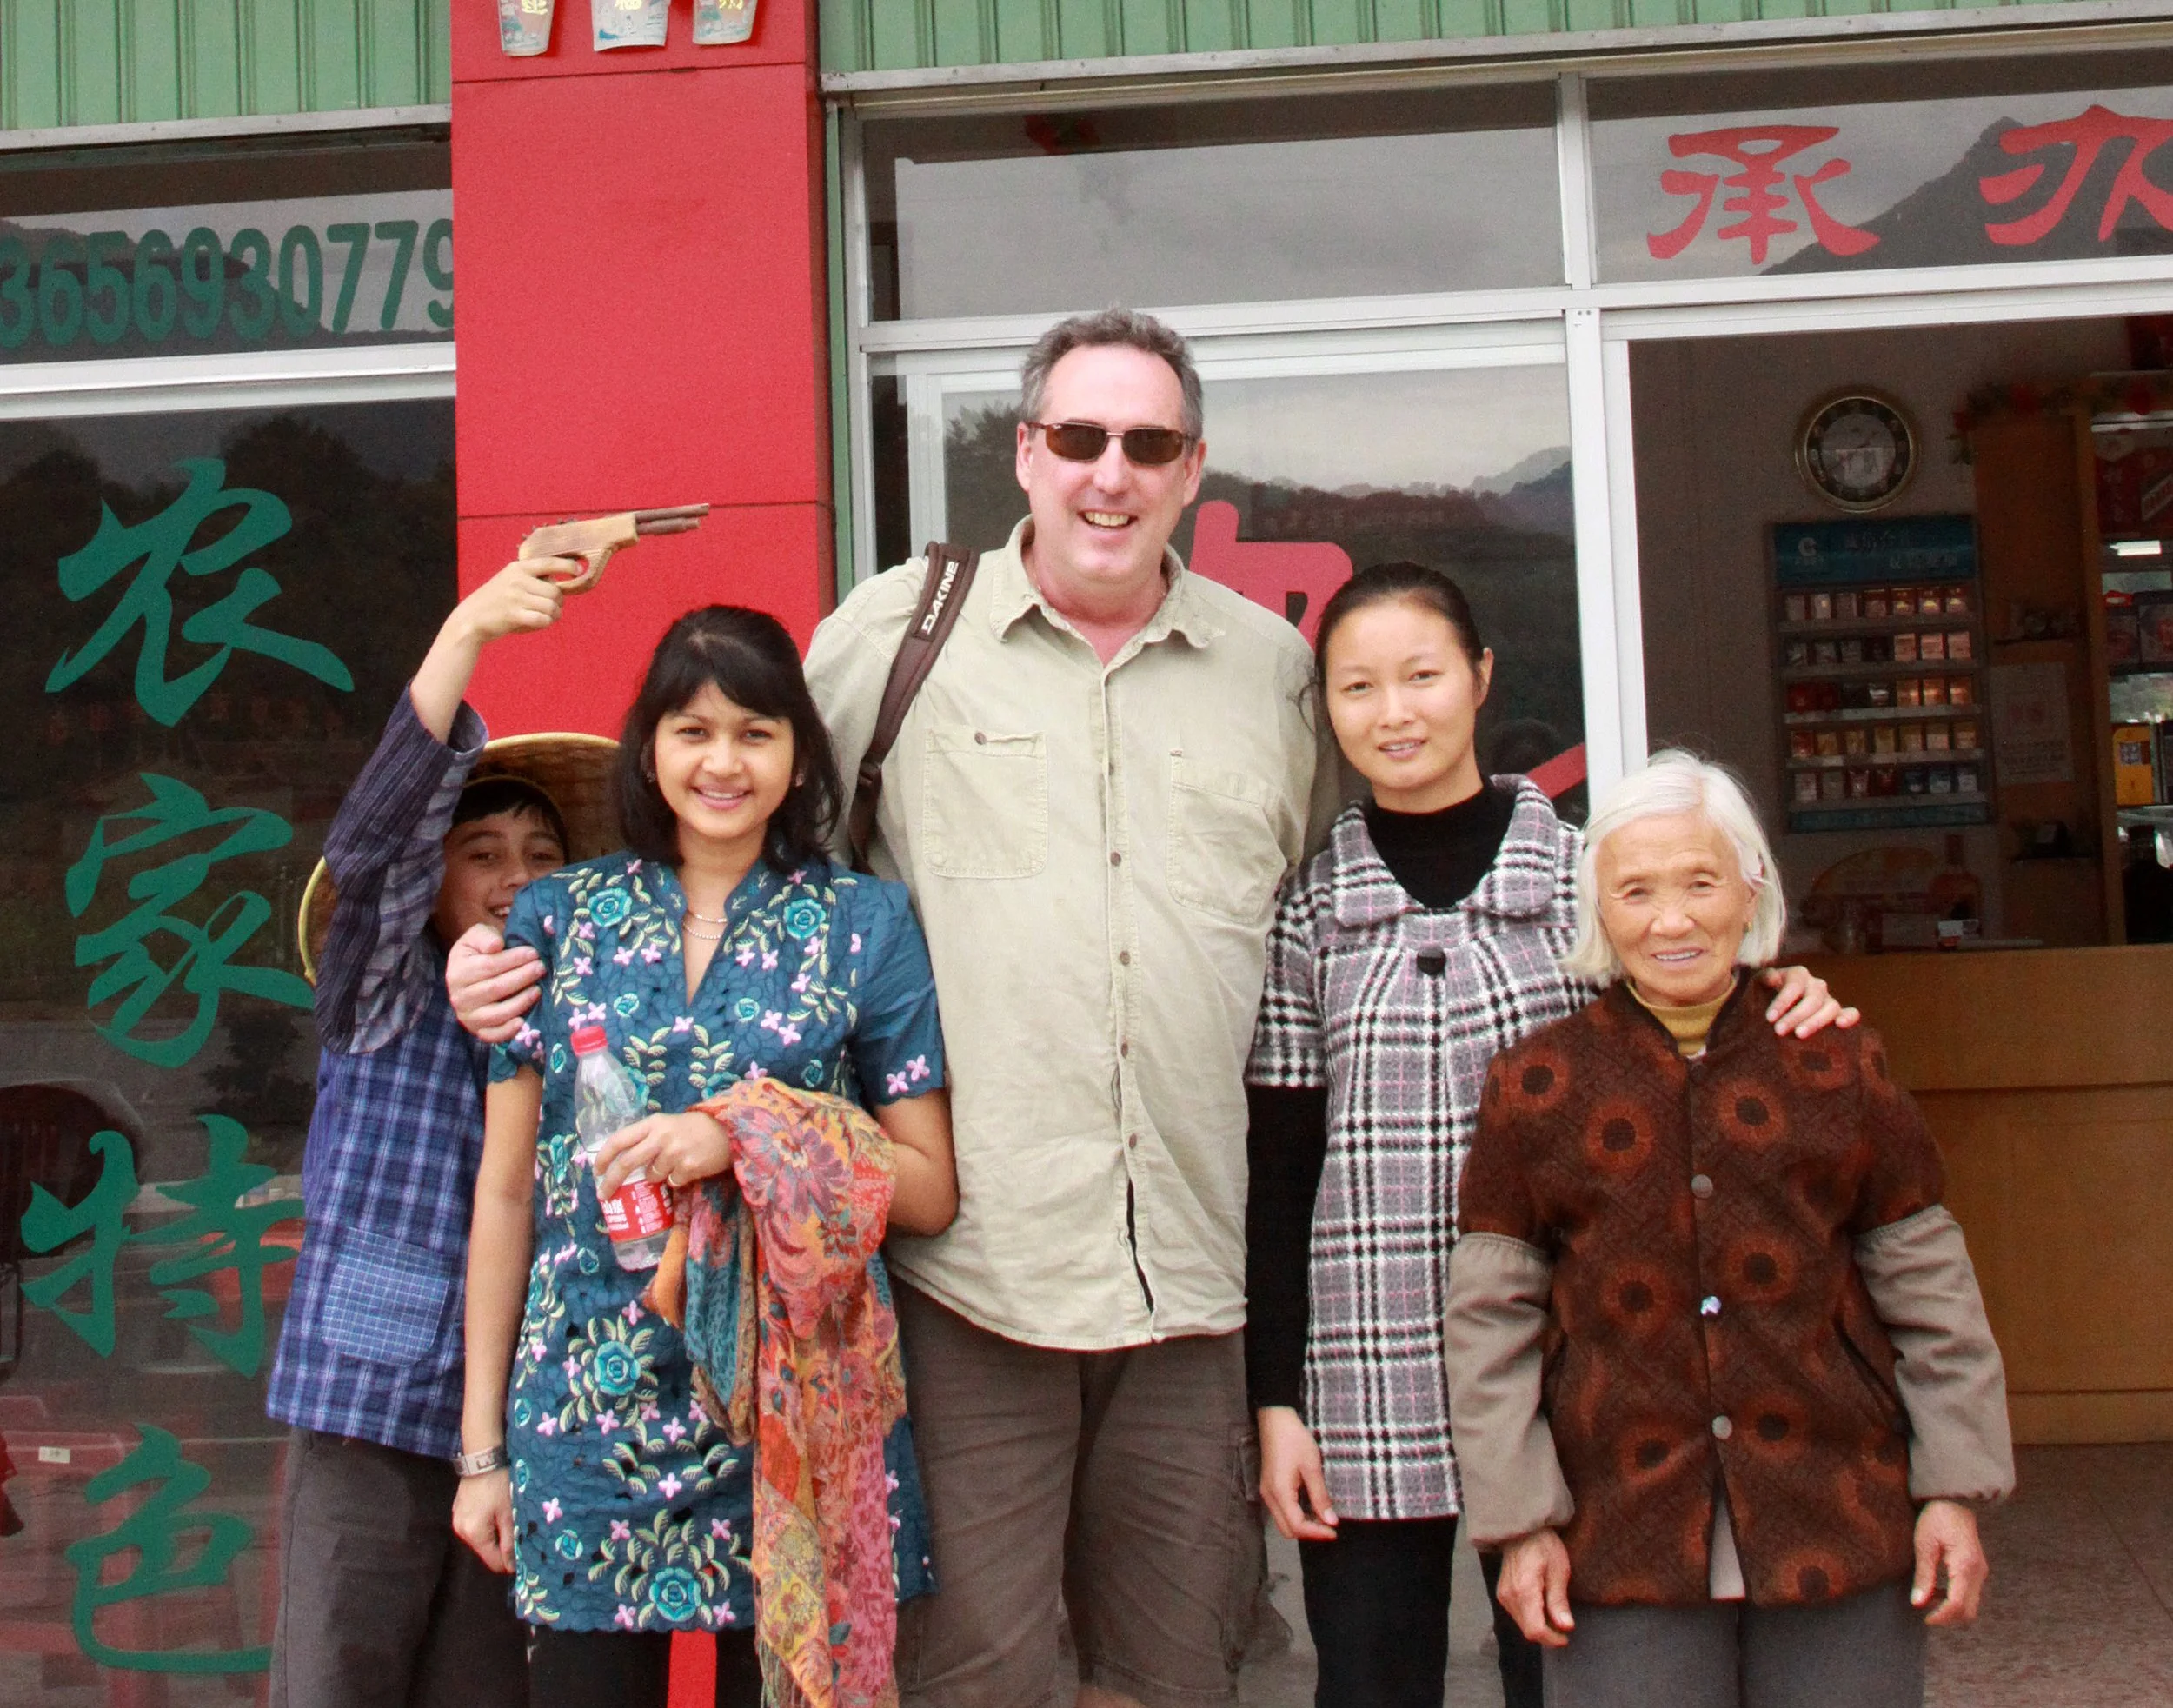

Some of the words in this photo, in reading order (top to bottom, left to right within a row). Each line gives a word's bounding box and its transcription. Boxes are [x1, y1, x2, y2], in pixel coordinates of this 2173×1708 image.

[921, 560, 960, 635] DAKINE
[19, 456, 355, 1674] 农家特色
